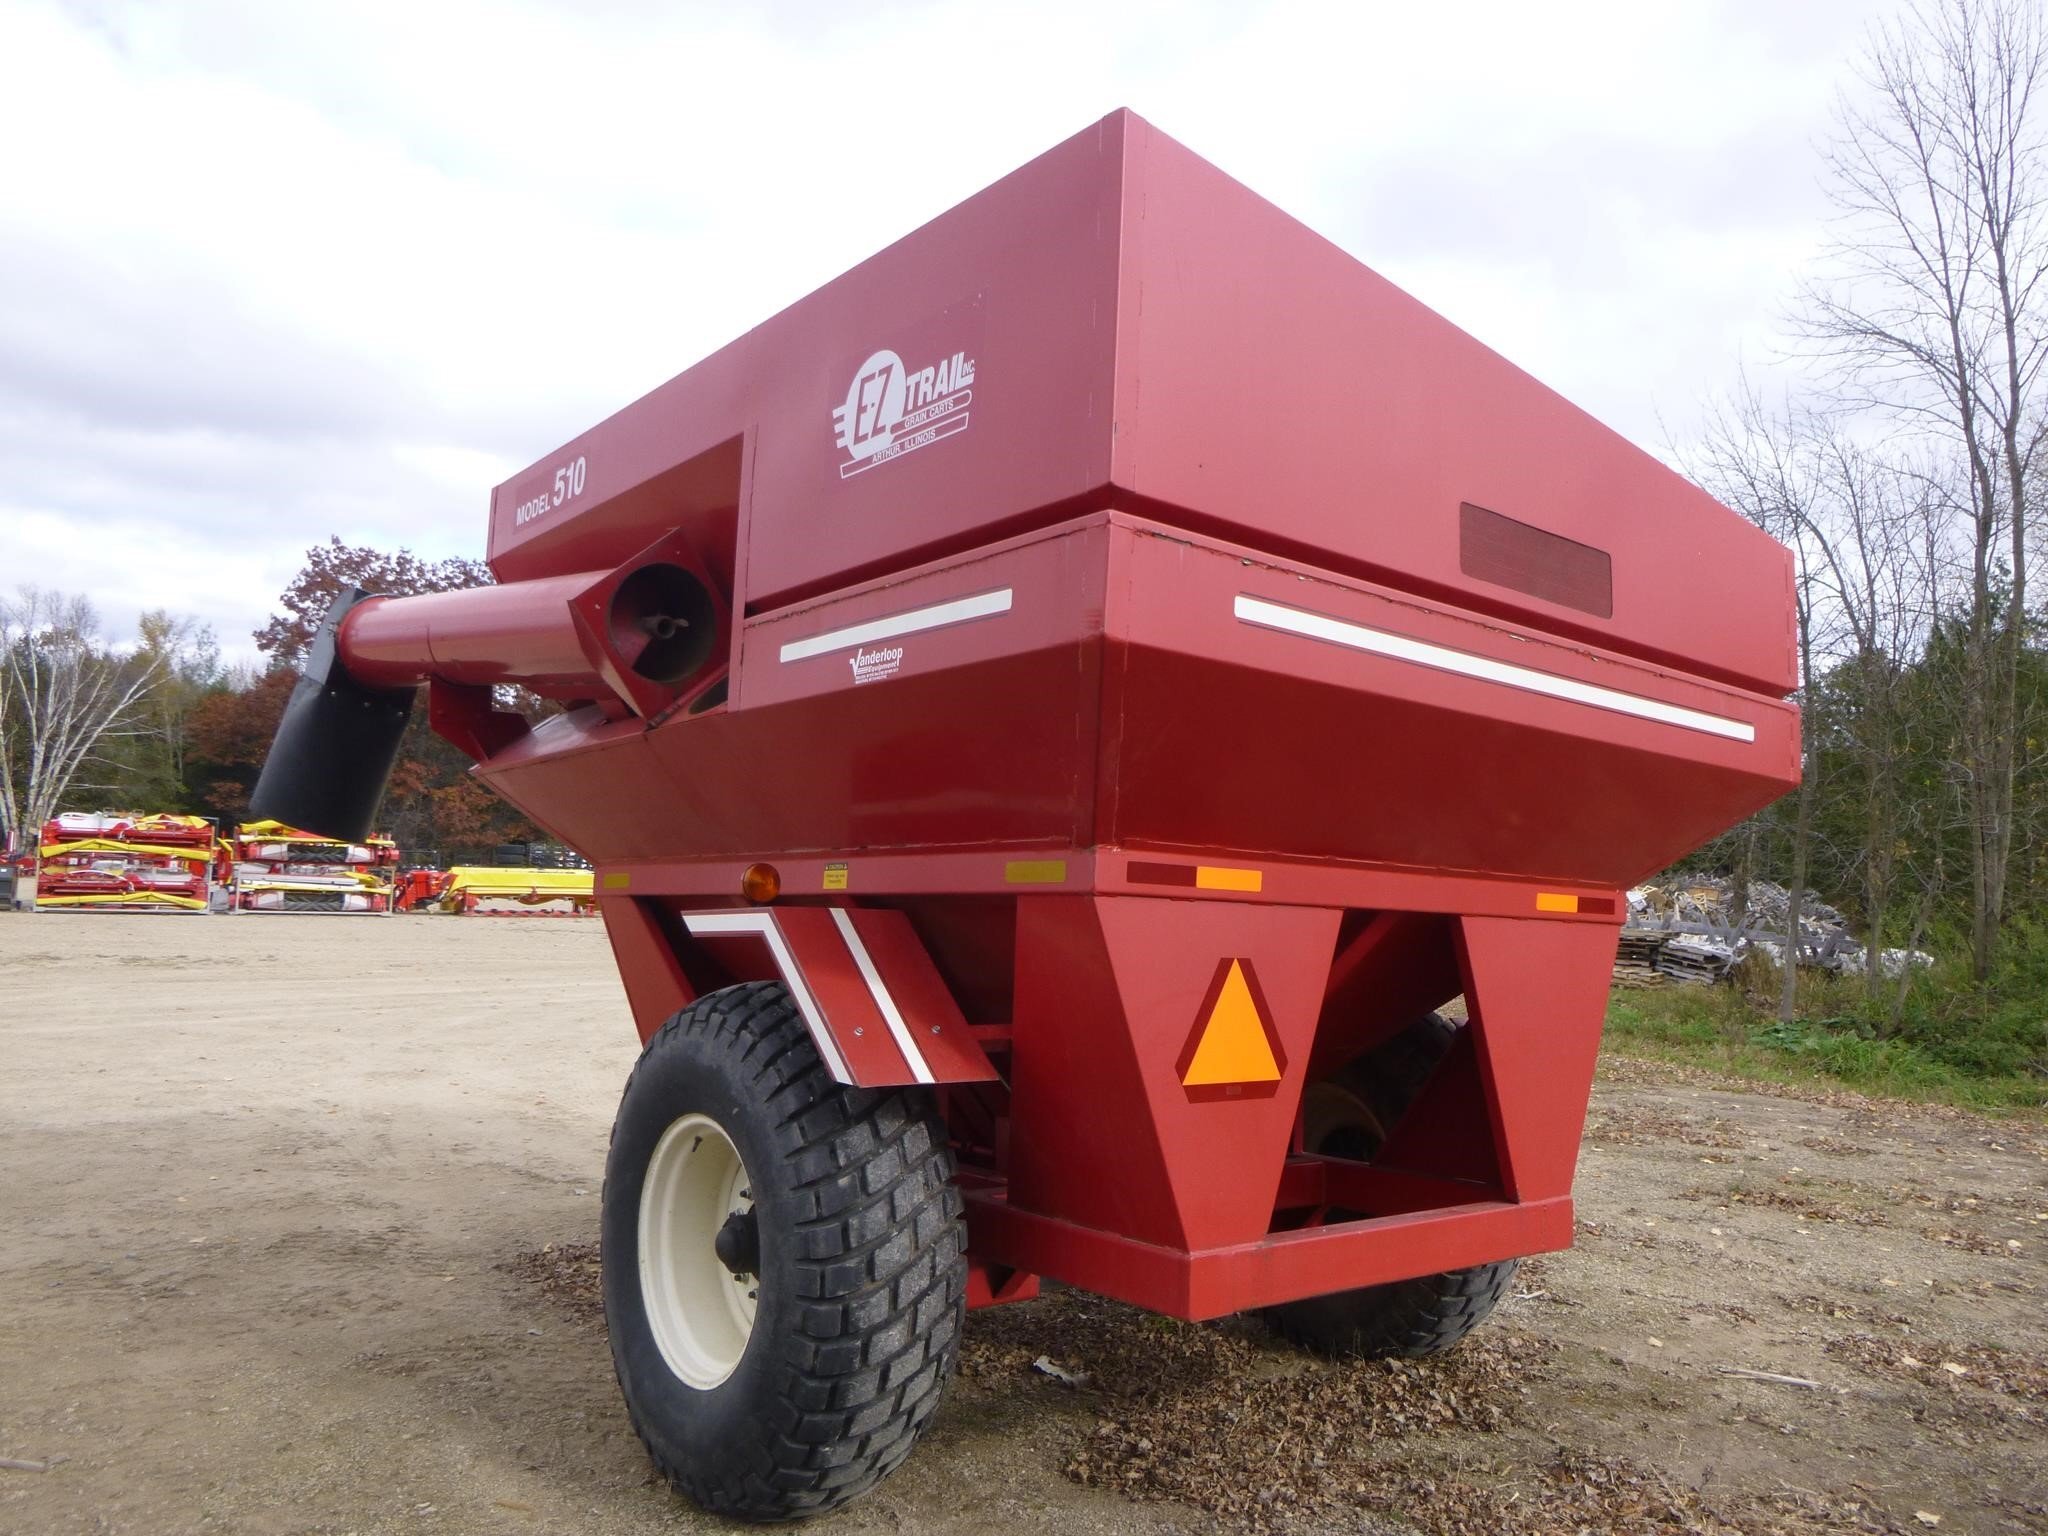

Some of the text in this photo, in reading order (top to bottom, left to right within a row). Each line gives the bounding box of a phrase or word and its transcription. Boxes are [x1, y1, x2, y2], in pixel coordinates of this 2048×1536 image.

[907, 351, 975, 411] TRAIL
[904, 399, 954, 429] GRAIN CARTS
[904, 429, 936, 450] ILLINOIS
[516, 456, 586, 526] MODEL 510
[849, 647, 903, 678] Vanderloop
